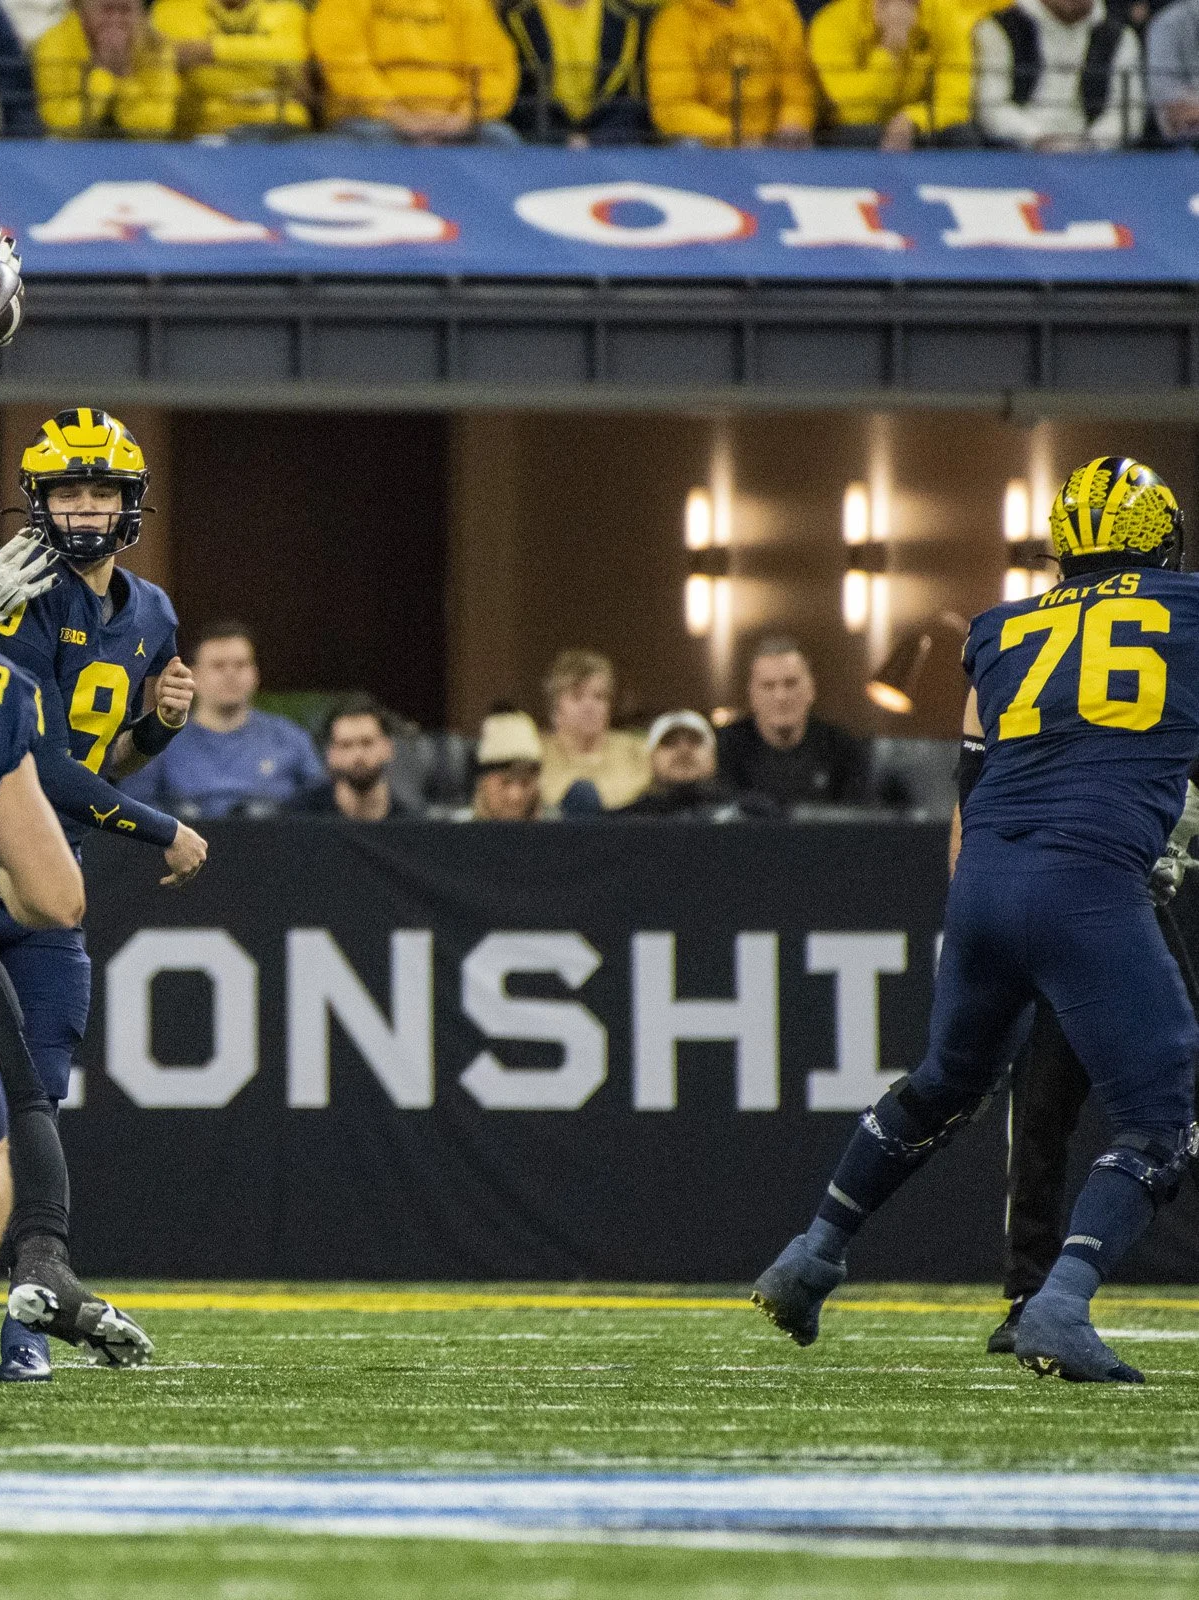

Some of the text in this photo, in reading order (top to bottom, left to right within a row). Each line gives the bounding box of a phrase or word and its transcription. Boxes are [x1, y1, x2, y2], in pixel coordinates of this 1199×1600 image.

[513, 181, 1135, 252] OIL
[68, 661, 130, 775] 9
[998, 597, 1171, 741] 76
